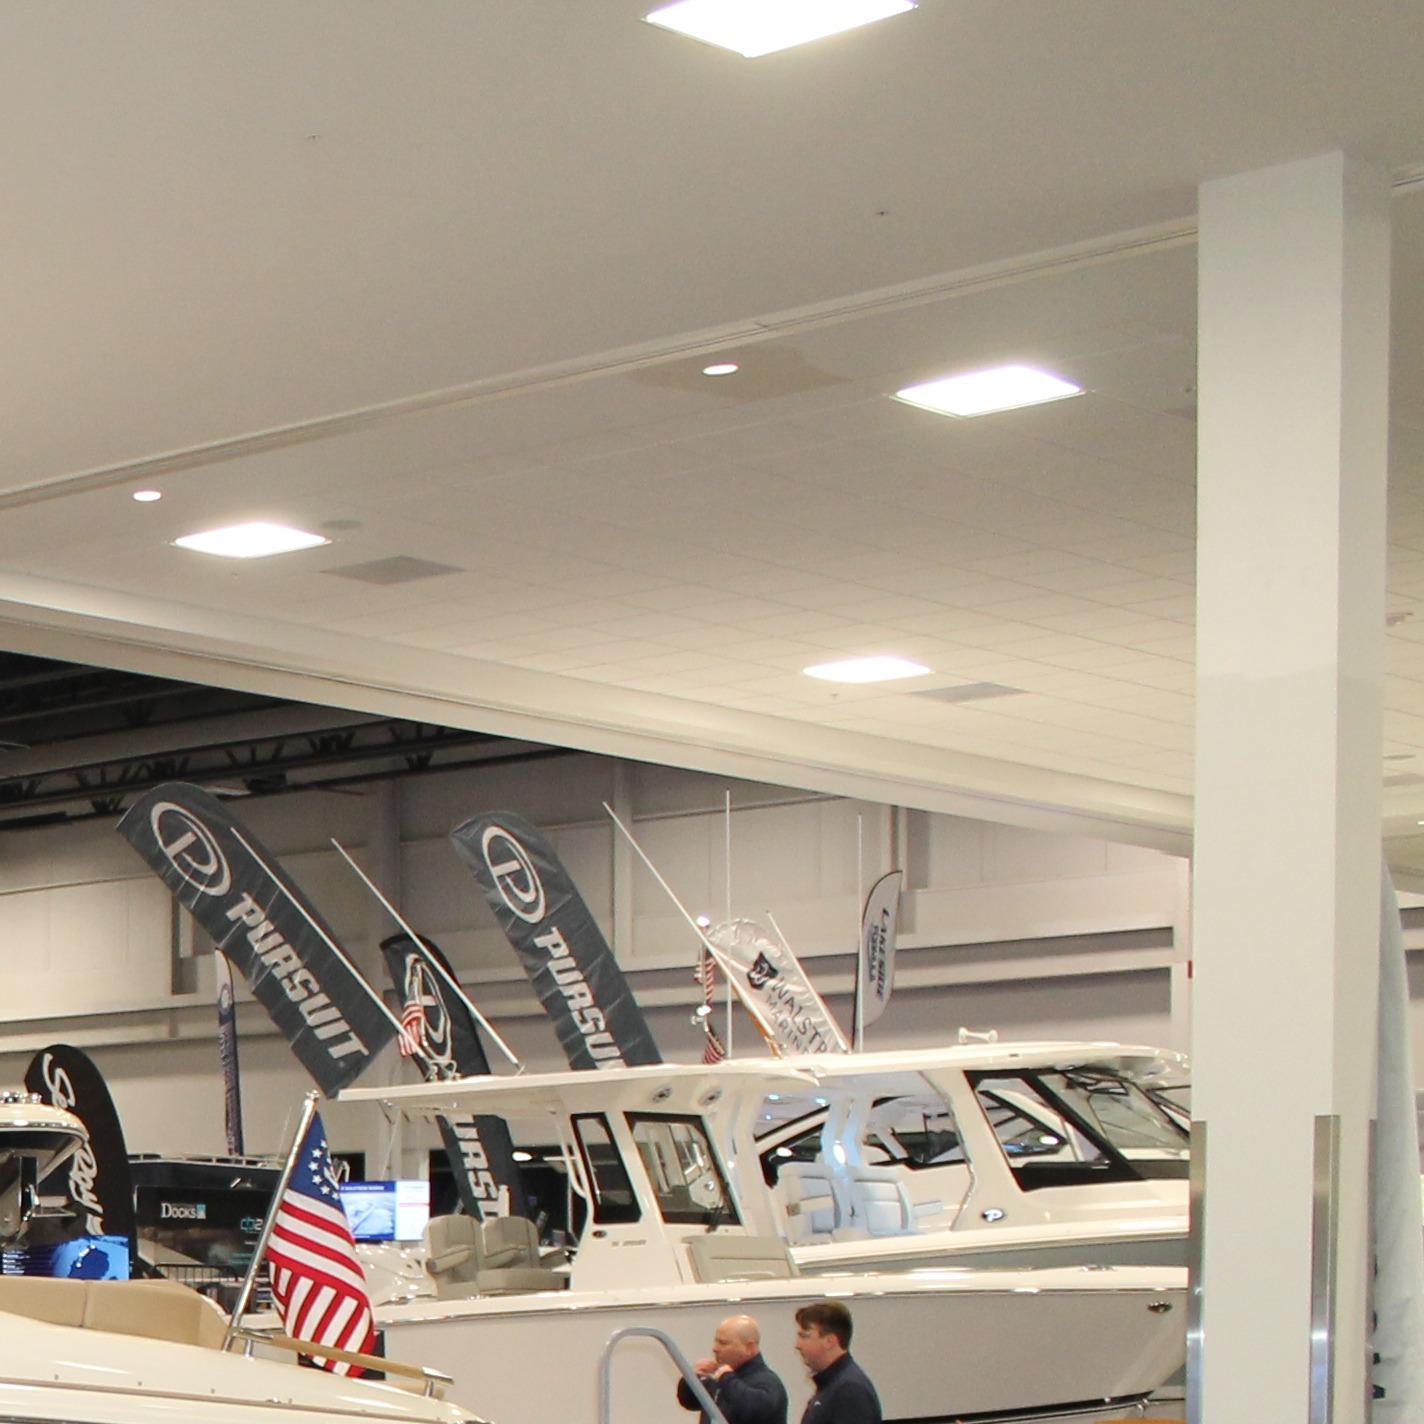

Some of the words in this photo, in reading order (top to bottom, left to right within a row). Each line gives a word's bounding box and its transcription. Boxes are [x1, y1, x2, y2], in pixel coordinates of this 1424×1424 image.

[225, 891, 370, 1060] PURSUIT
[533, 926, 628, 1070] PURSUI
[771, 975, 828, 1054] WALSTR
